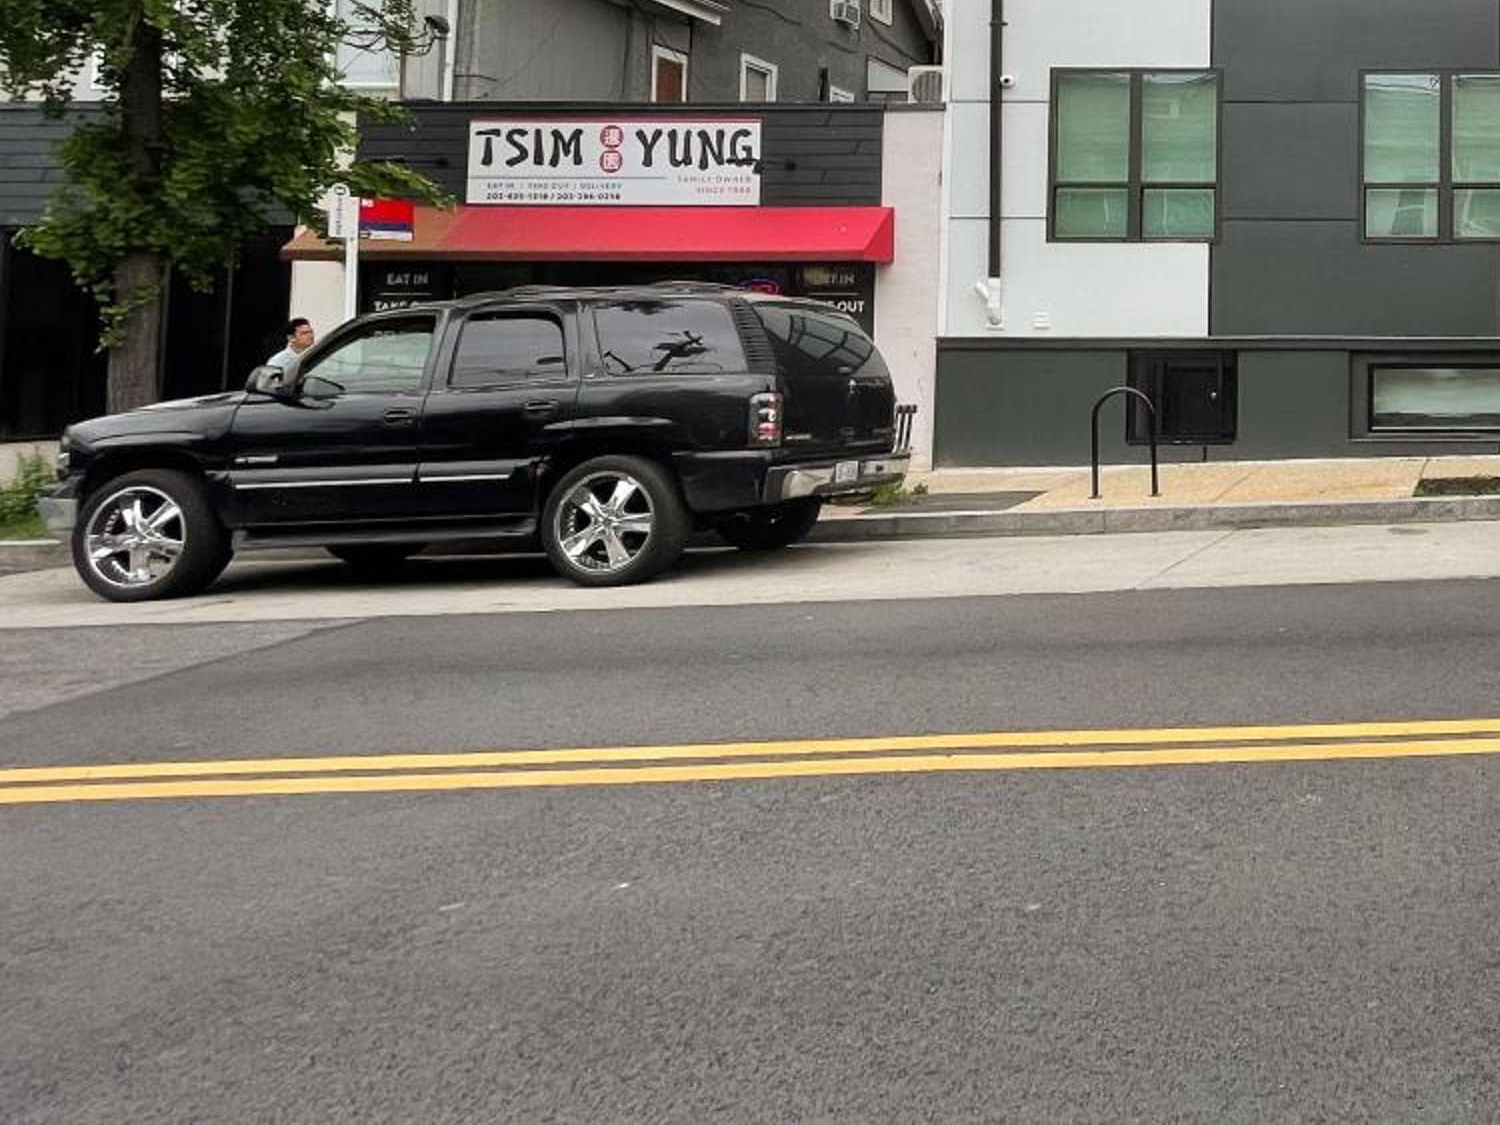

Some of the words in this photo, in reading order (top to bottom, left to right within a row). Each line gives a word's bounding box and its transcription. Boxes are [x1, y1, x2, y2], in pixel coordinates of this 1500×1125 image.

[475, 128, 584, 168] TSIM
[635, 128, 754, 171] YUNG
[387, 273, 411, 286] EAT
[413, 273, 429, 285] IN
[836, 300, 865, 313] OUT
